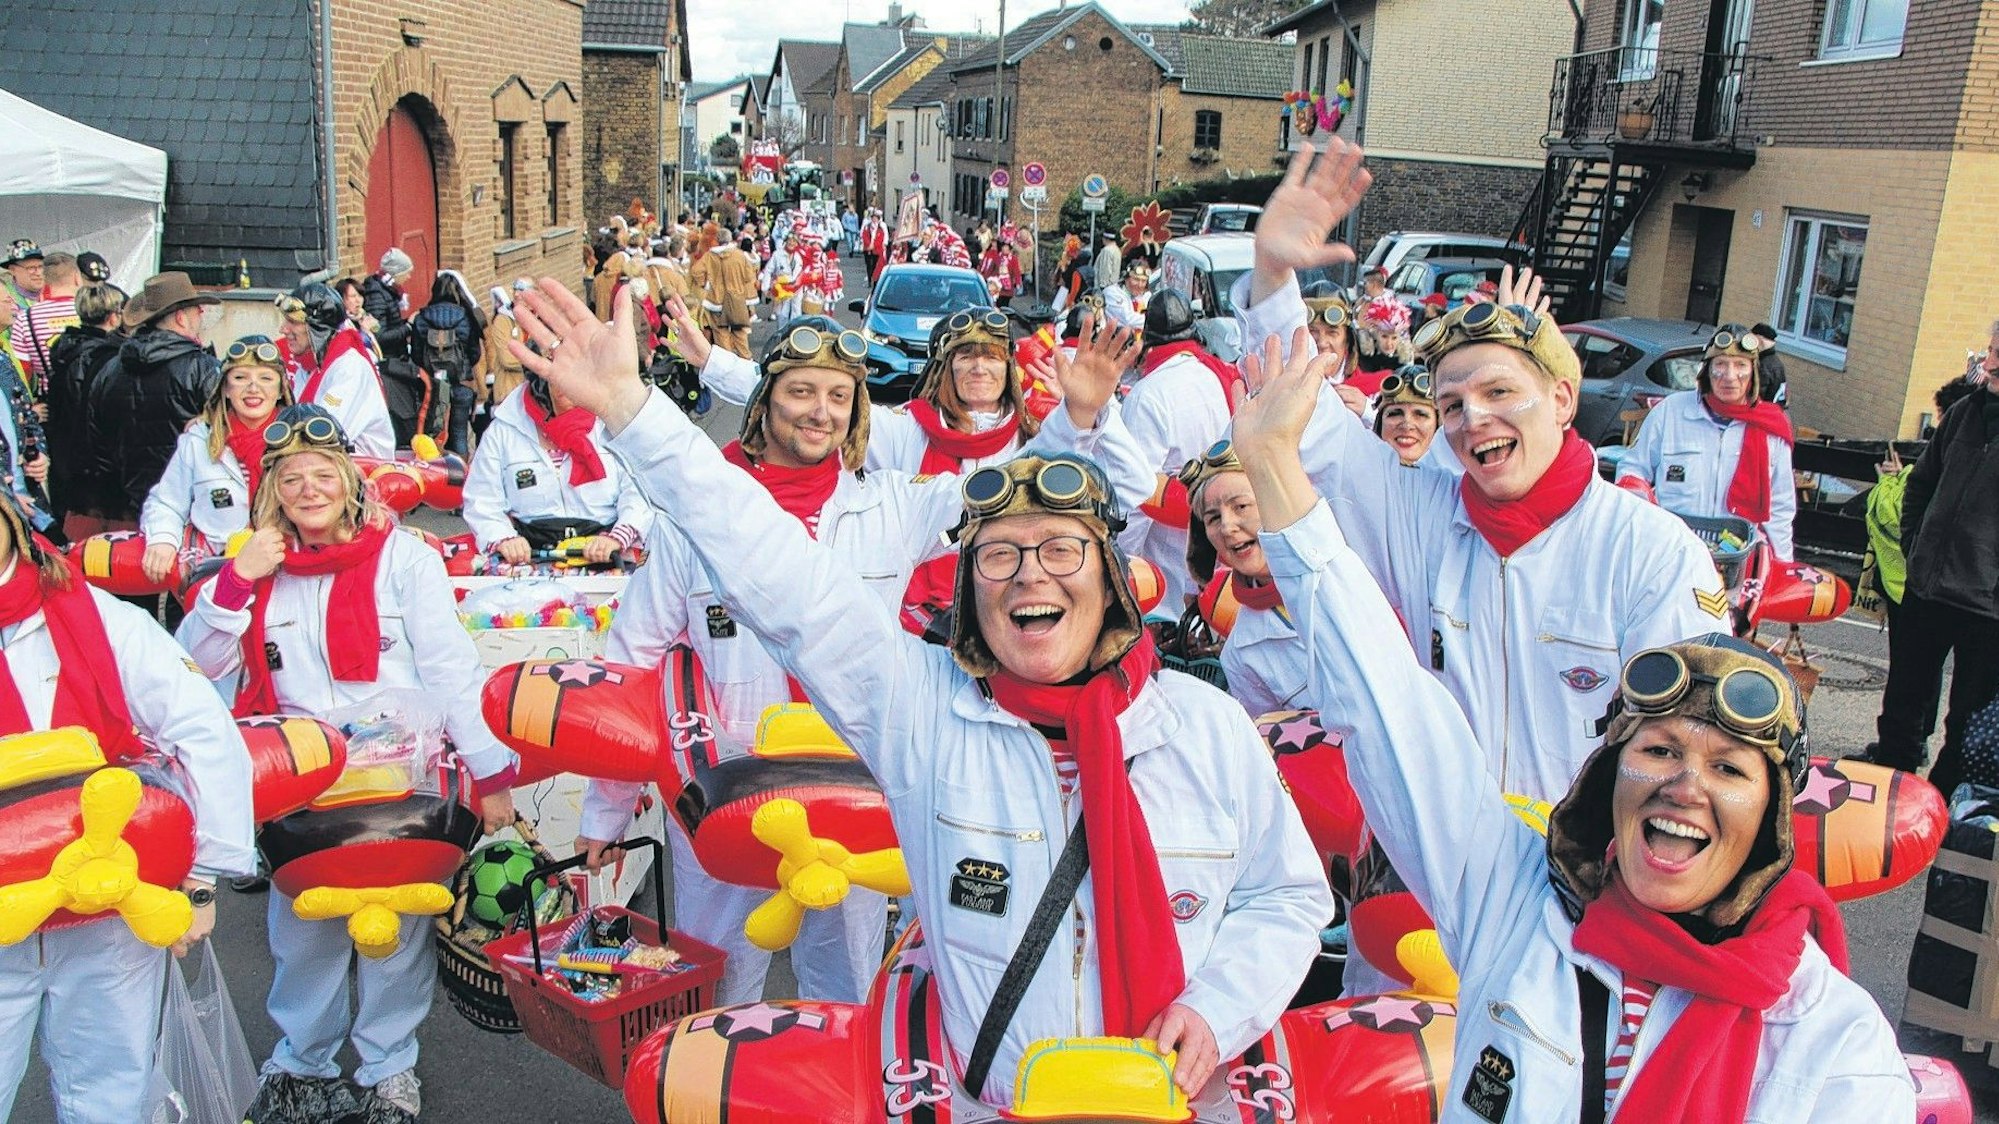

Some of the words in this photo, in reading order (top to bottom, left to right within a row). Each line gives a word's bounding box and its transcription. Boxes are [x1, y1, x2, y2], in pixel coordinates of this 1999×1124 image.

[1741, 577, 1764, 602] 53
[669, 710, 716, 751] 53
[884, 1058, 953, 1117] 53
[1225, 1062, 1295, 1121] 53
